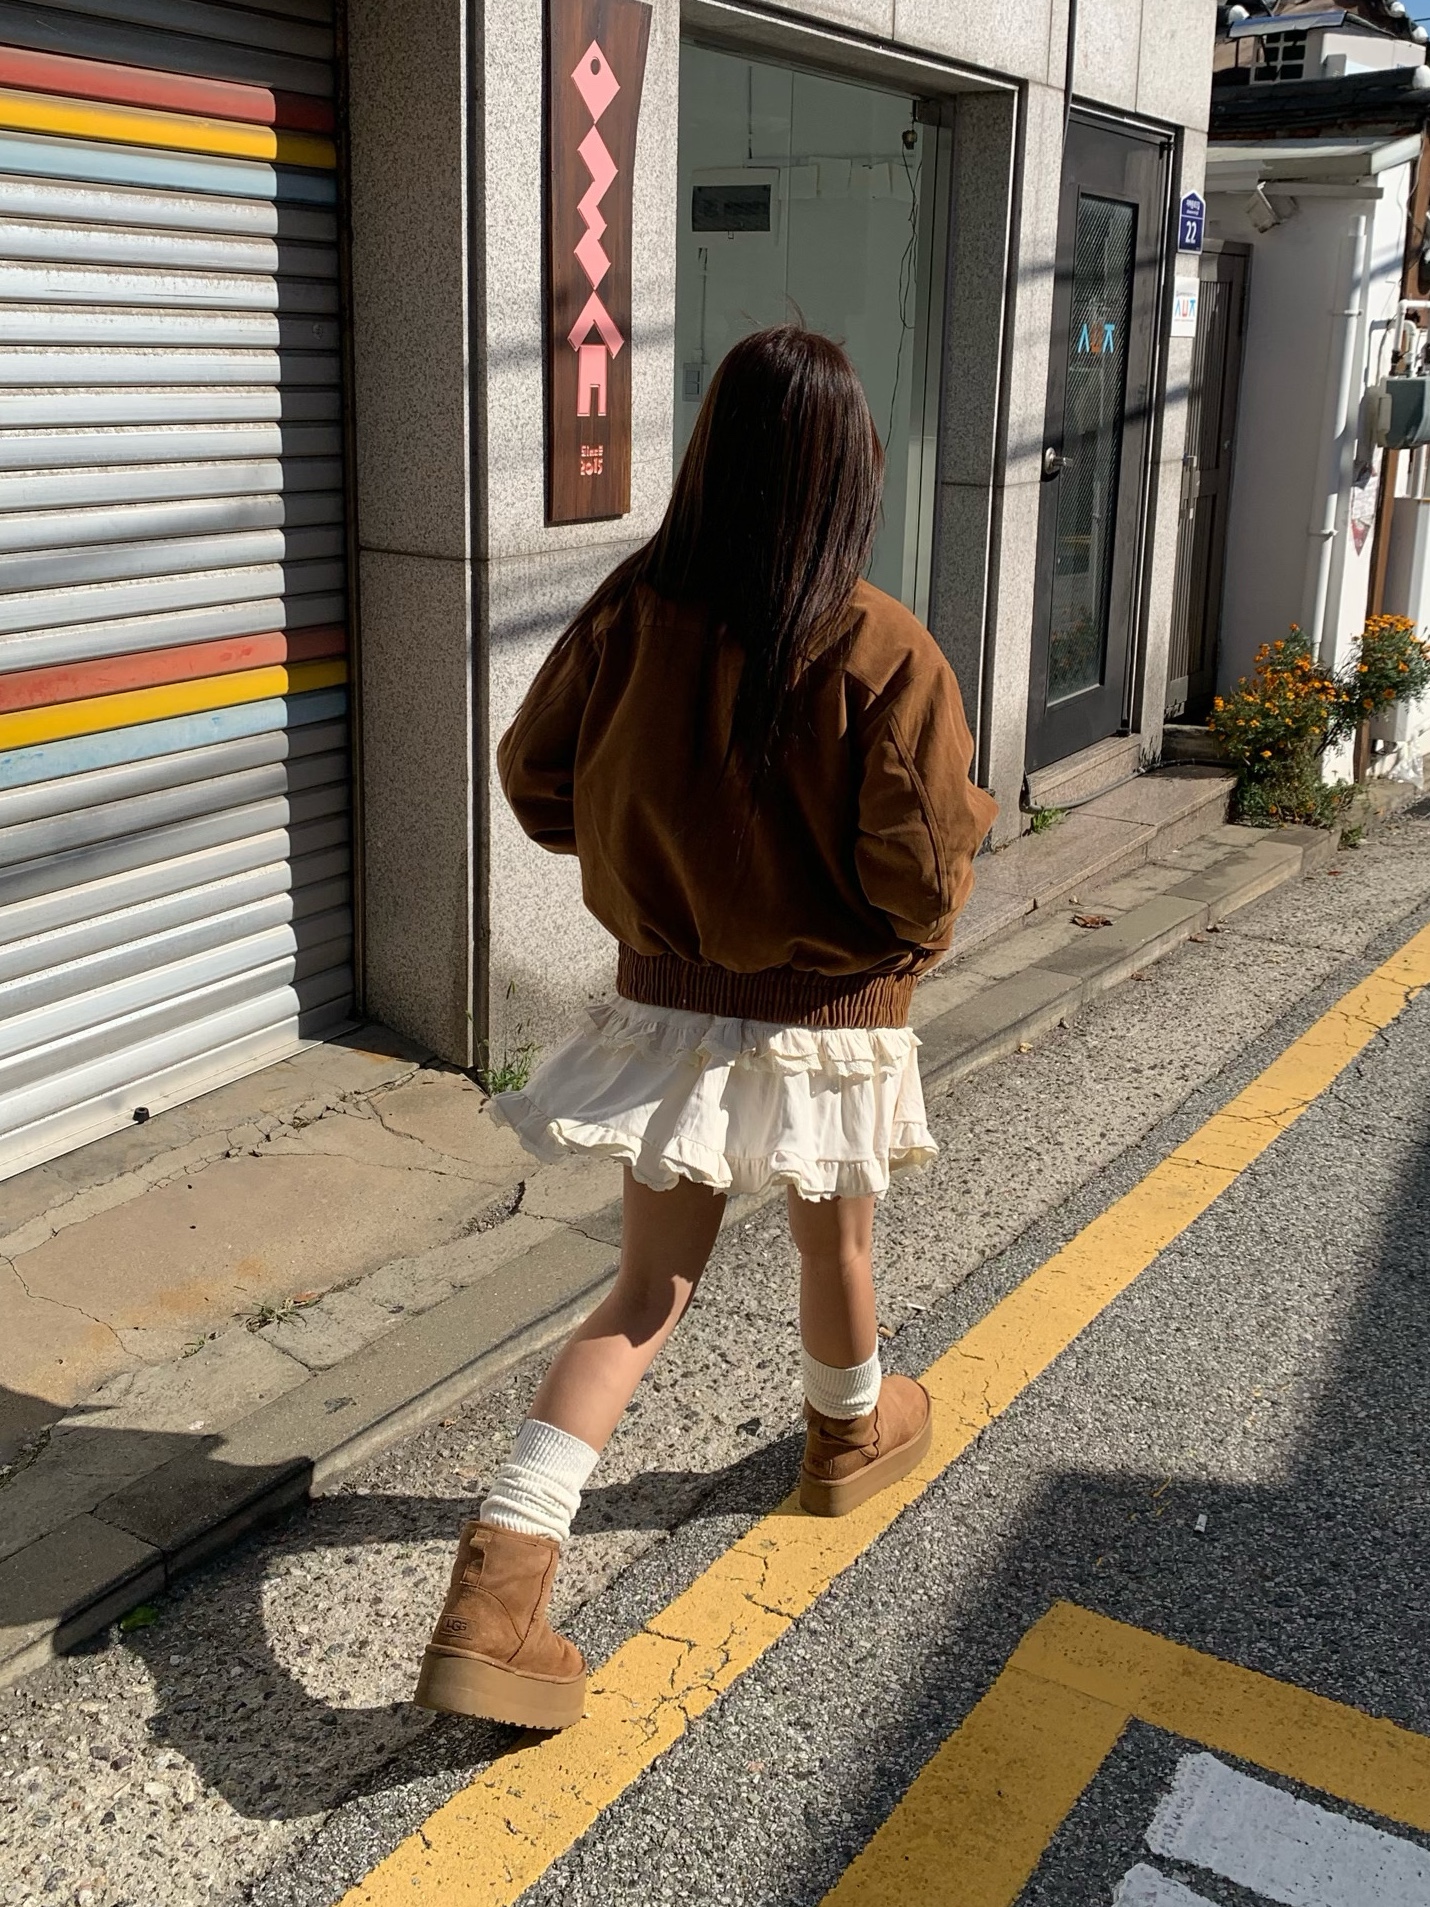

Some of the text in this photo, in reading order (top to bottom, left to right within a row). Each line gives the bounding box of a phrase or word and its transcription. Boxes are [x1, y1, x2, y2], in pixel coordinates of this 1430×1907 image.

[1185, 220, 1197, 244] 22
[580, 457, 604, 476] 2015
[446, 1618, 468, 1632] UGG
